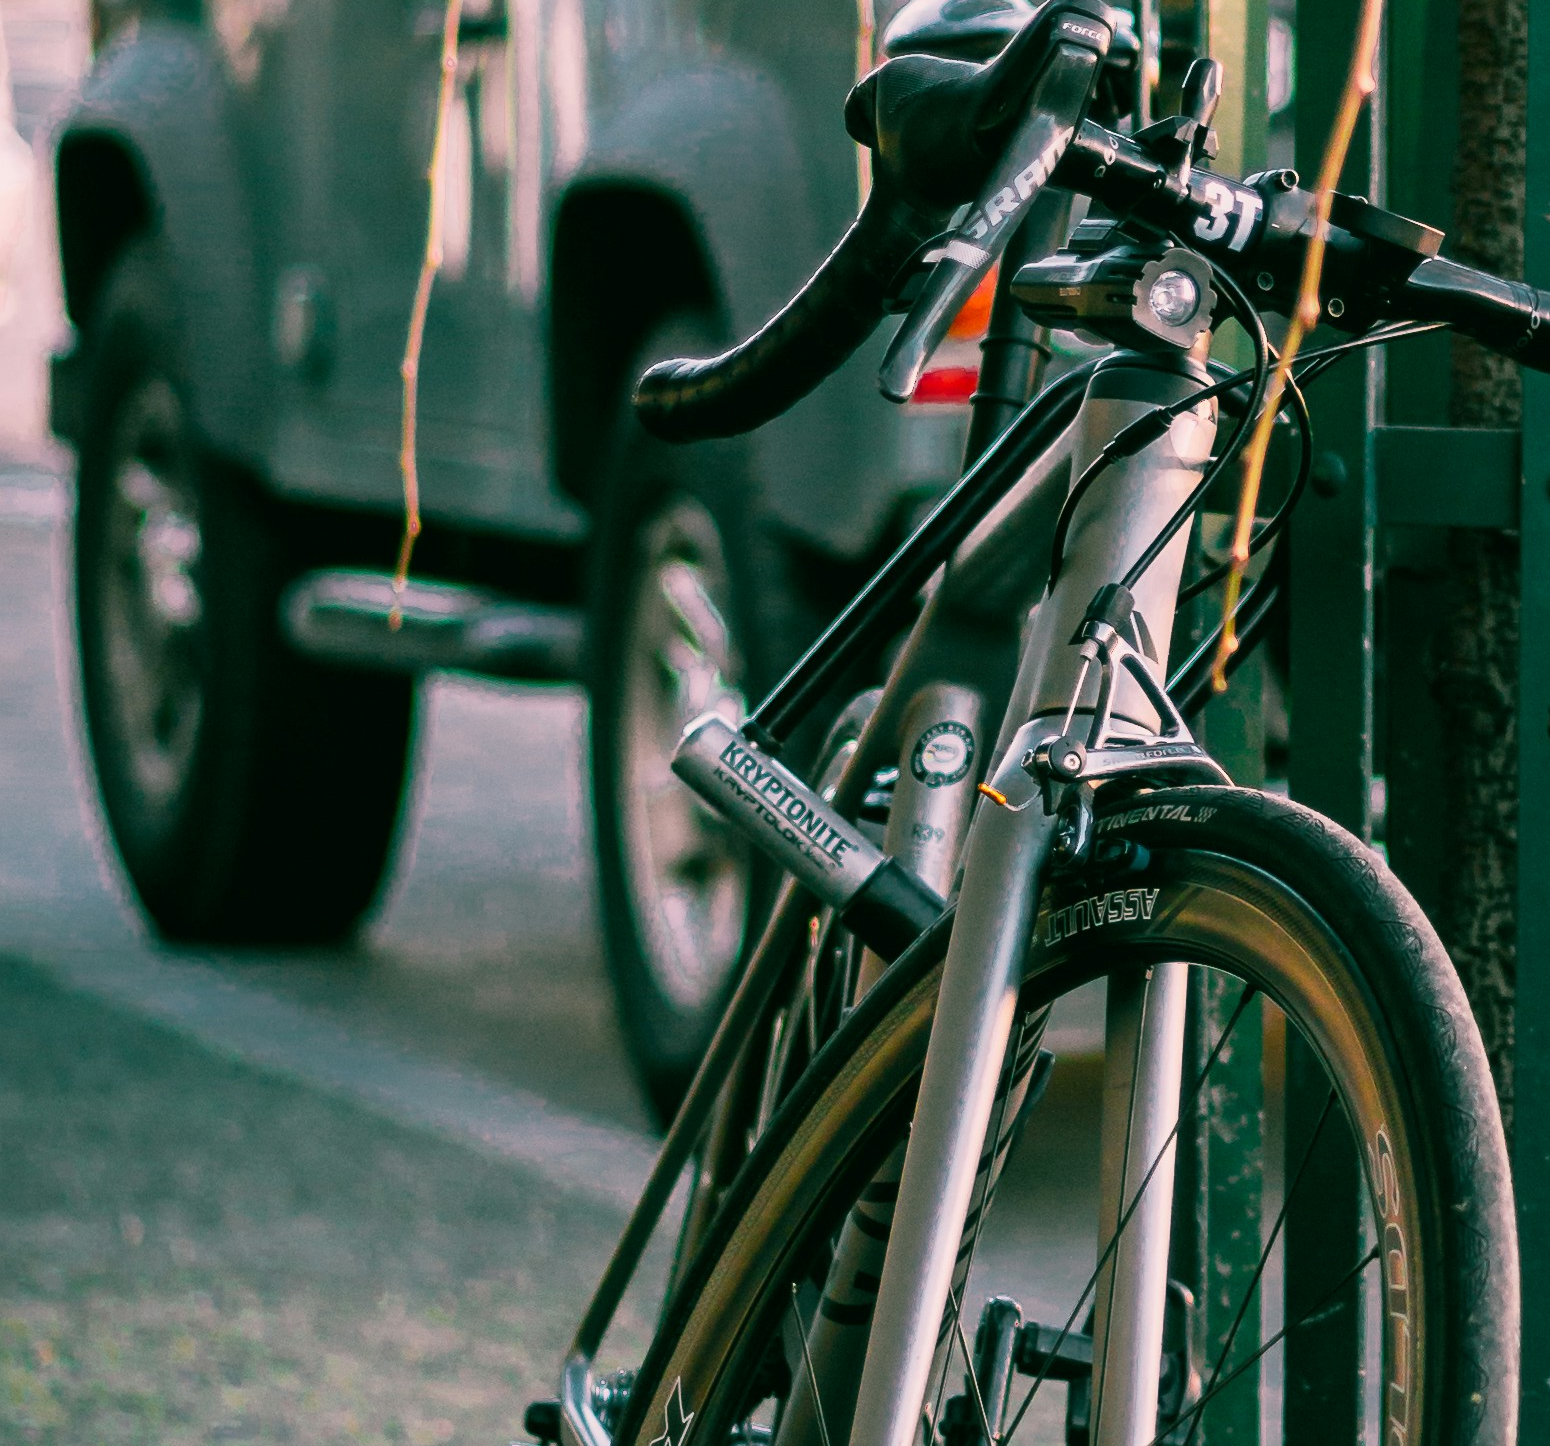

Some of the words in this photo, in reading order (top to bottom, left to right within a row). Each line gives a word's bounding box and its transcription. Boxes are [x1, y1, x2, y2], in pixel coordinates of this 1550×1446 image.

[1193, 181, 1263, 252] 3T
[718, 740, 854, 863] KRYPTONITE
[1097, 805, 1192, 834] TINENTAL
[1044, 888, 1160, 947] ASSAULT
